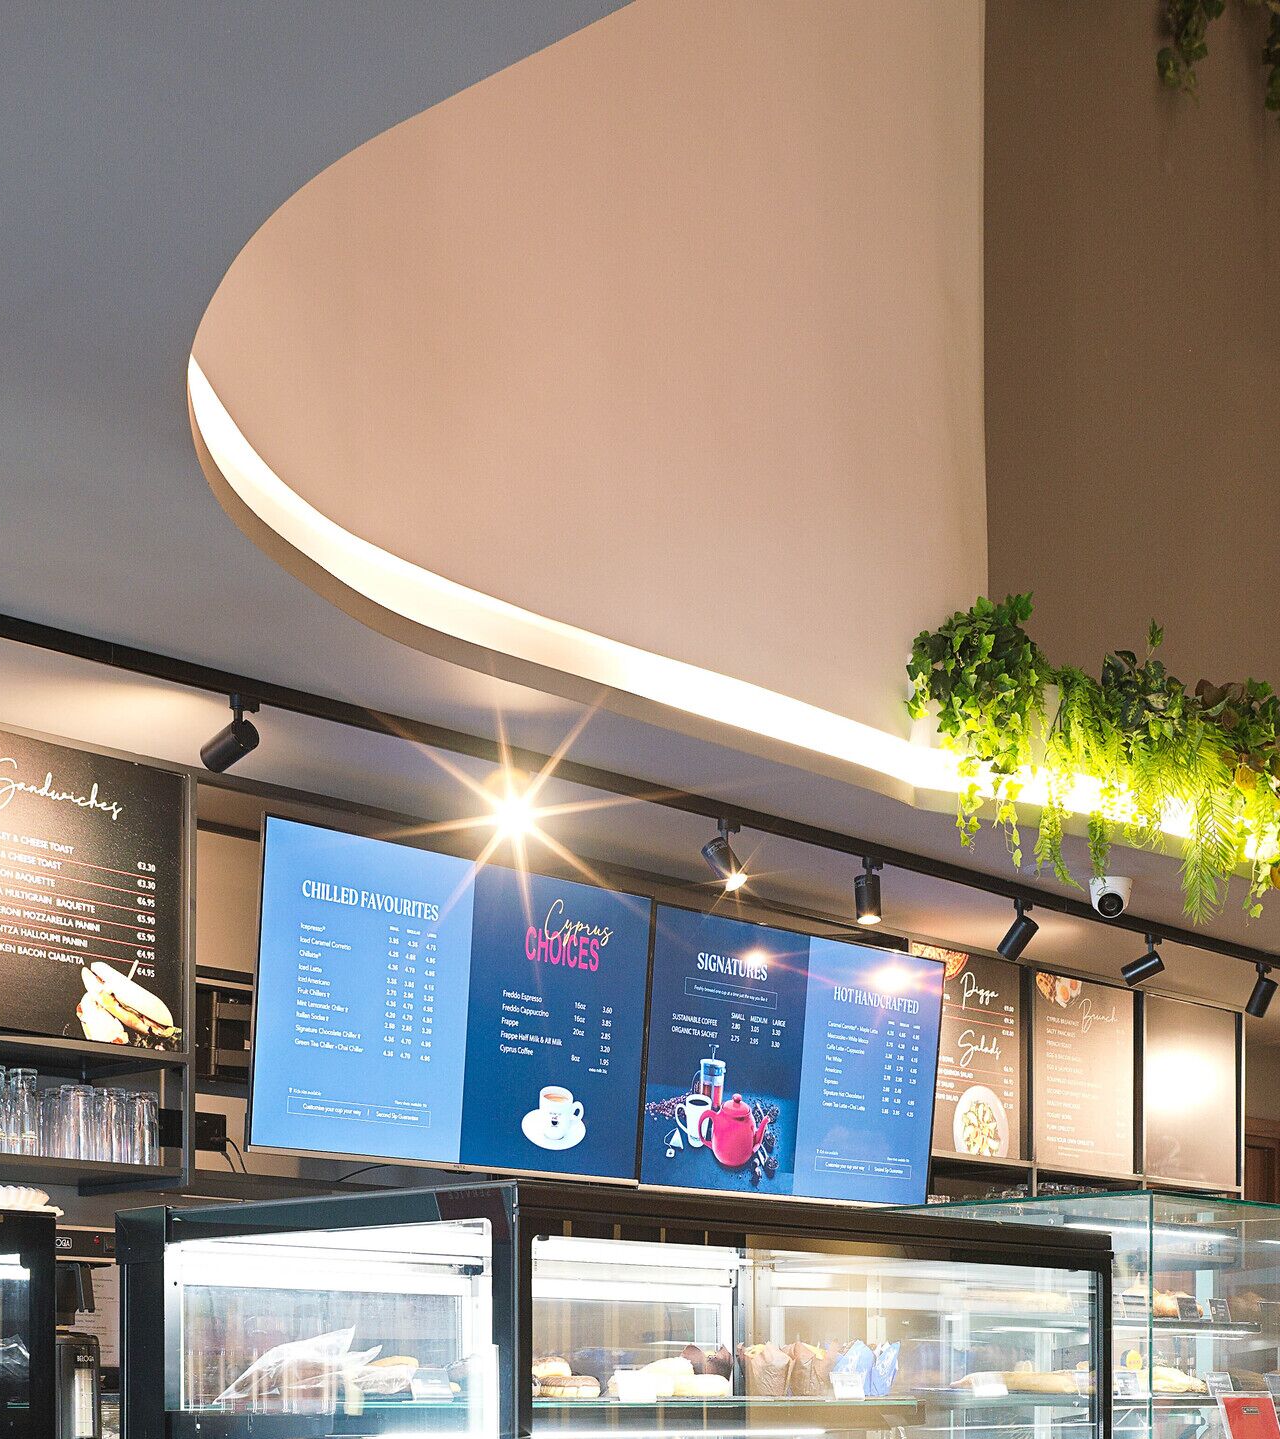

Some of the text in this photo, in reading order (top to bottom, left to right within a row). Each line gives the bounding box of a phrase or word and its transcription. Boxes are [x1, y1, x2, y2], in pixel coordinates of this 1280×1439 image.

[21, 837, 48, 849] CHEESE
[49, 841, 74, 855] TOAST
[137, 861, 156, 873] €3.30
[8, 852, 36, 865] CHEESE
[37, 857, 62, 870] TOAST
[137, 879, 156, 891] €3.30
[5, 888, 52, 905] MULTIGRAIN
[137, 914, 156, 926] €5.90
[137, 897, 156, 909] €6.95
[302, 880, 439, 921] CHILLED FAVOURITES
[23, 910, 73, 928] MOZZARELLA
[75, 920, 101, 932] PANINI
[137, 932, 156, 944] €5.90
[544, 899, 614, 947] Cyprus
[20, 929, 61, 943] HALLOUMI
[62, 935, 88, 948] PANINI
[136, 949, 155, 961] €4.95
[525, 926, 600, 972] CHOICES
[17, 945, 46, 959] BACON
[48, 951, 85, 966] CIABATTA
[136, 966, 155, 978] €4.95
[697, 952, 768, 981] SIGNATURES
[502, 990, 613, 1014] Freddo Espresso 16oz 3.60
[833, 985, 920, 1015] HOT HANDCRAFTED
[960, 971, 999, 1010] Pizza
[501, 1003, 612, 1028] Freddo Cappuccino 16oz 3.85
[501, 1017, 611, 1041] Frappe 20oz 2.85
[672, 1013, 702, 1025] SUSTAINABLE
[701, 1016, 718, 1027] COFFEE
[731, 1012, 786, 1028] SMALL MEDIUM LARGE
[1078, 998, 1119, 1034] Brunch
[500, 1030, 518, 1041] Frappe
[518, 1033, 530, 1042] Half
[529, 1034, 540, 1044] Milk
[552, 1037, 563, 1047] Milk
[600, 1045, 610, 1053] 3.20
[671, 1026, 693, 1036] ORGANIC
[692, 1028, 701, 1037] TEA
[700, 1029, 718, 1039] SACHET
[958, 1030, 1001, 1067] Salads
[499, 1044, 609, 1067] Cyprus Coffee 8oz 1.95
